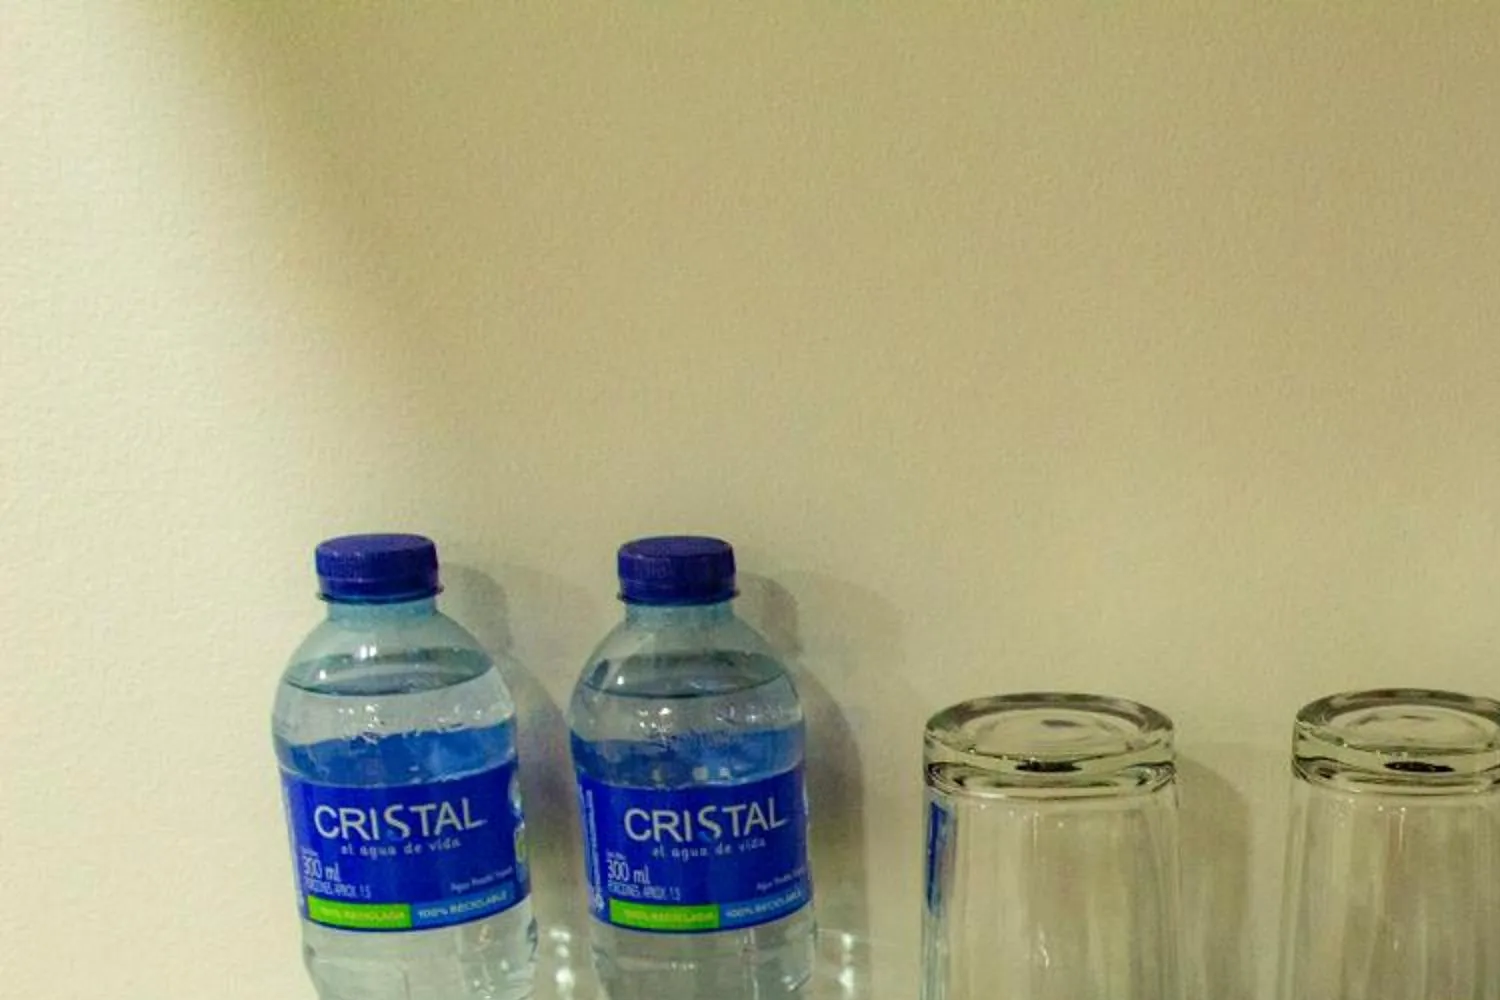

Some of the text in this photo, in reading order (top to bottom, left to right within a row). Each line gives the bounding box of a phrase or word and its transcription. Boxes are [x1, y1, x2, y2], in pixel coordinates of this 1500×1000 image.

[314, 798, 487, 841] CRISTAL
[624, 797, 787, 843] CRISTAL
[360, 846, 396, 860] agua
[403, 841, 422, 855] de
[428, 836, 462, 851] vida
[671, 846, 709, 861] agua
[716, 842, 731, 855] de
[607, 858, 630, 882] 300
